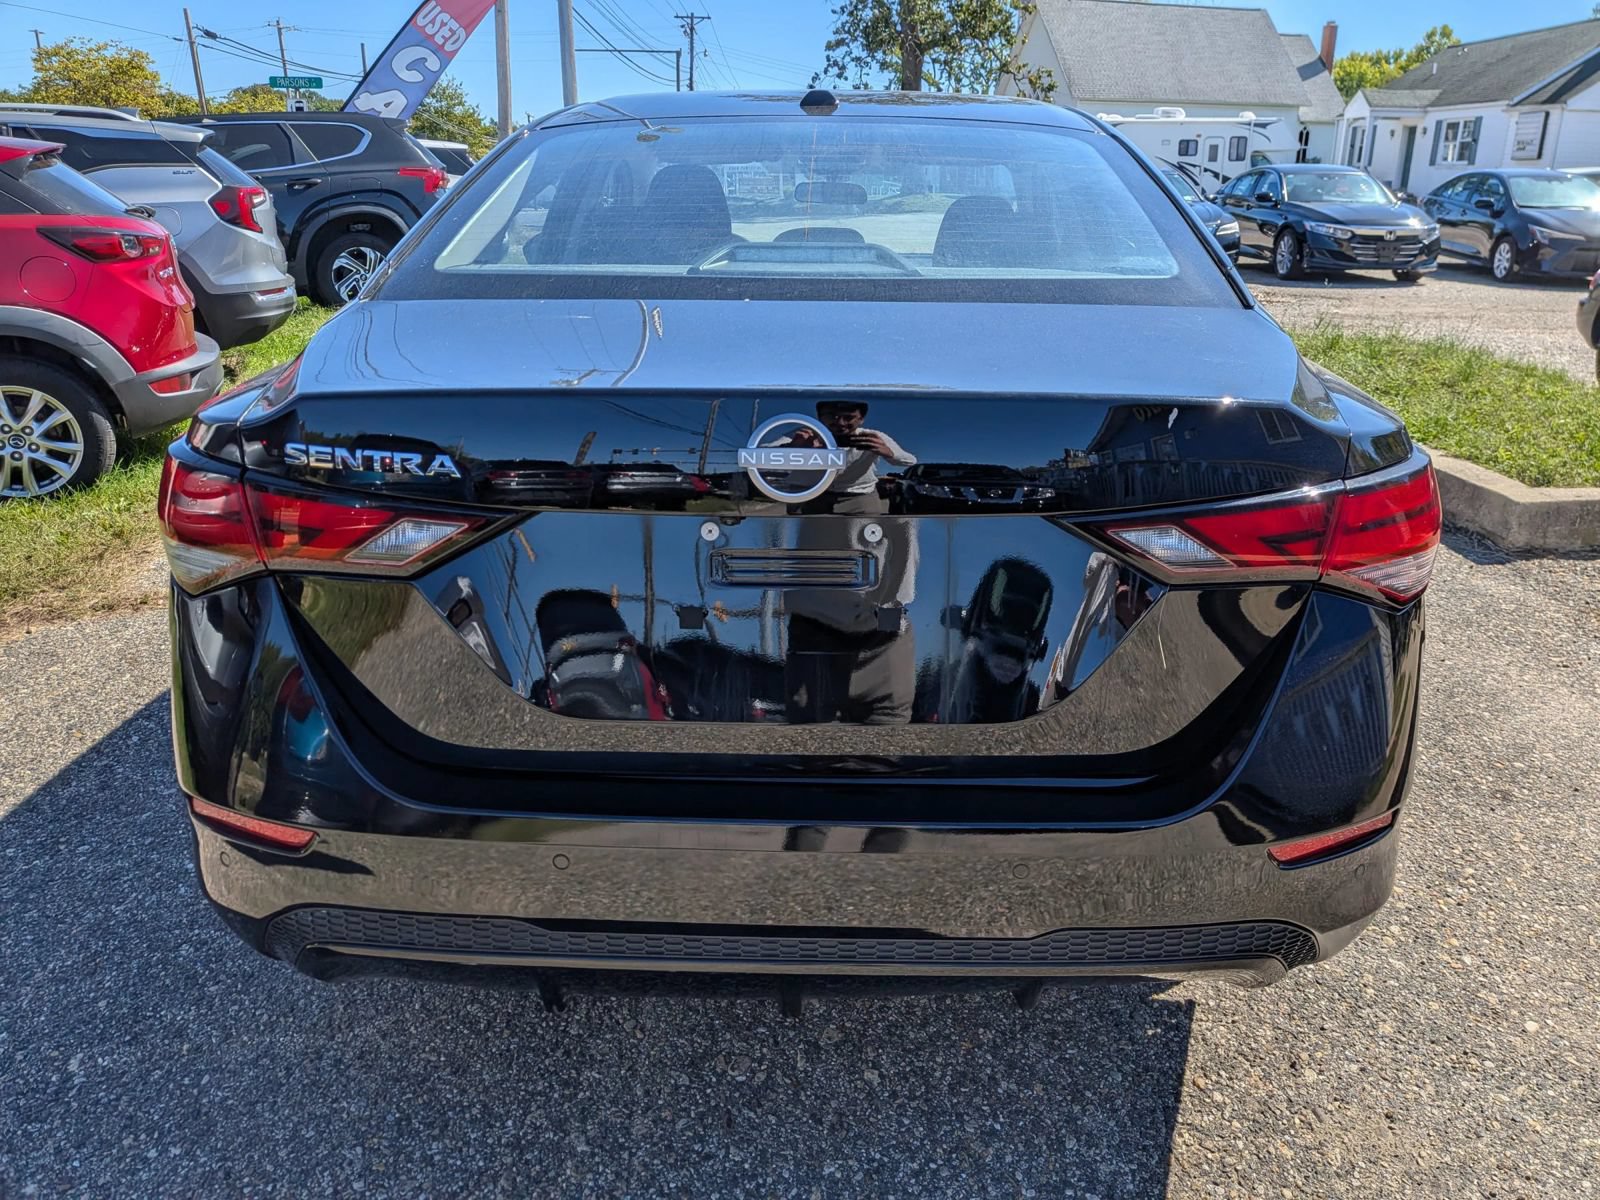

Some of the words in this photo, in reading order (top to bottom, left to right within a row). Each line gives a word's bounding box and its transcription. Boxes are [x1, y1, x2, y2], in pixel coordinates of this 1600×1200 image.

[416, 0, 467, 52] USED
[276, 77, 310, 87] PARSONS
[284, 442, 462, 478] SENTRA
[741, 451, 844, 466] NISSAN
